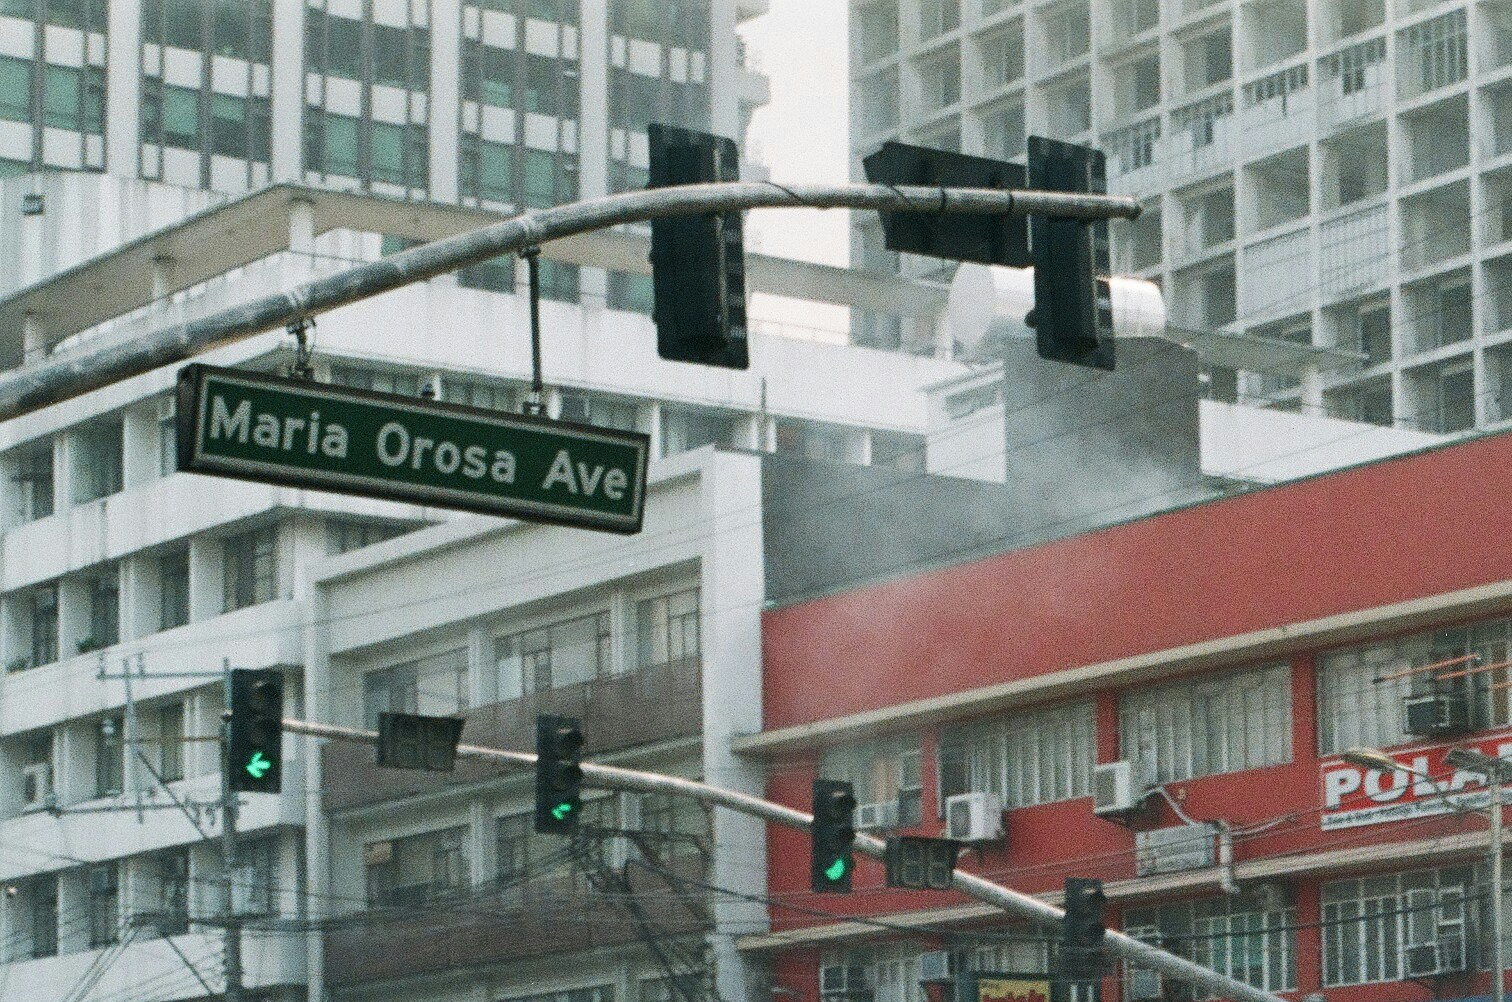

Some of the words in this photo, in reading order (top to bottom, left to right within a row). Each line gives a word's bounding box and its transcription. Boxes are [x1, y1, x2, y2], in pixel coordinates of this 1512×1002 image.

[209, 396, 348, 458] Maria
[376, 422, 516, 484] Orosa
[542, 449, 629, 500] Ave
